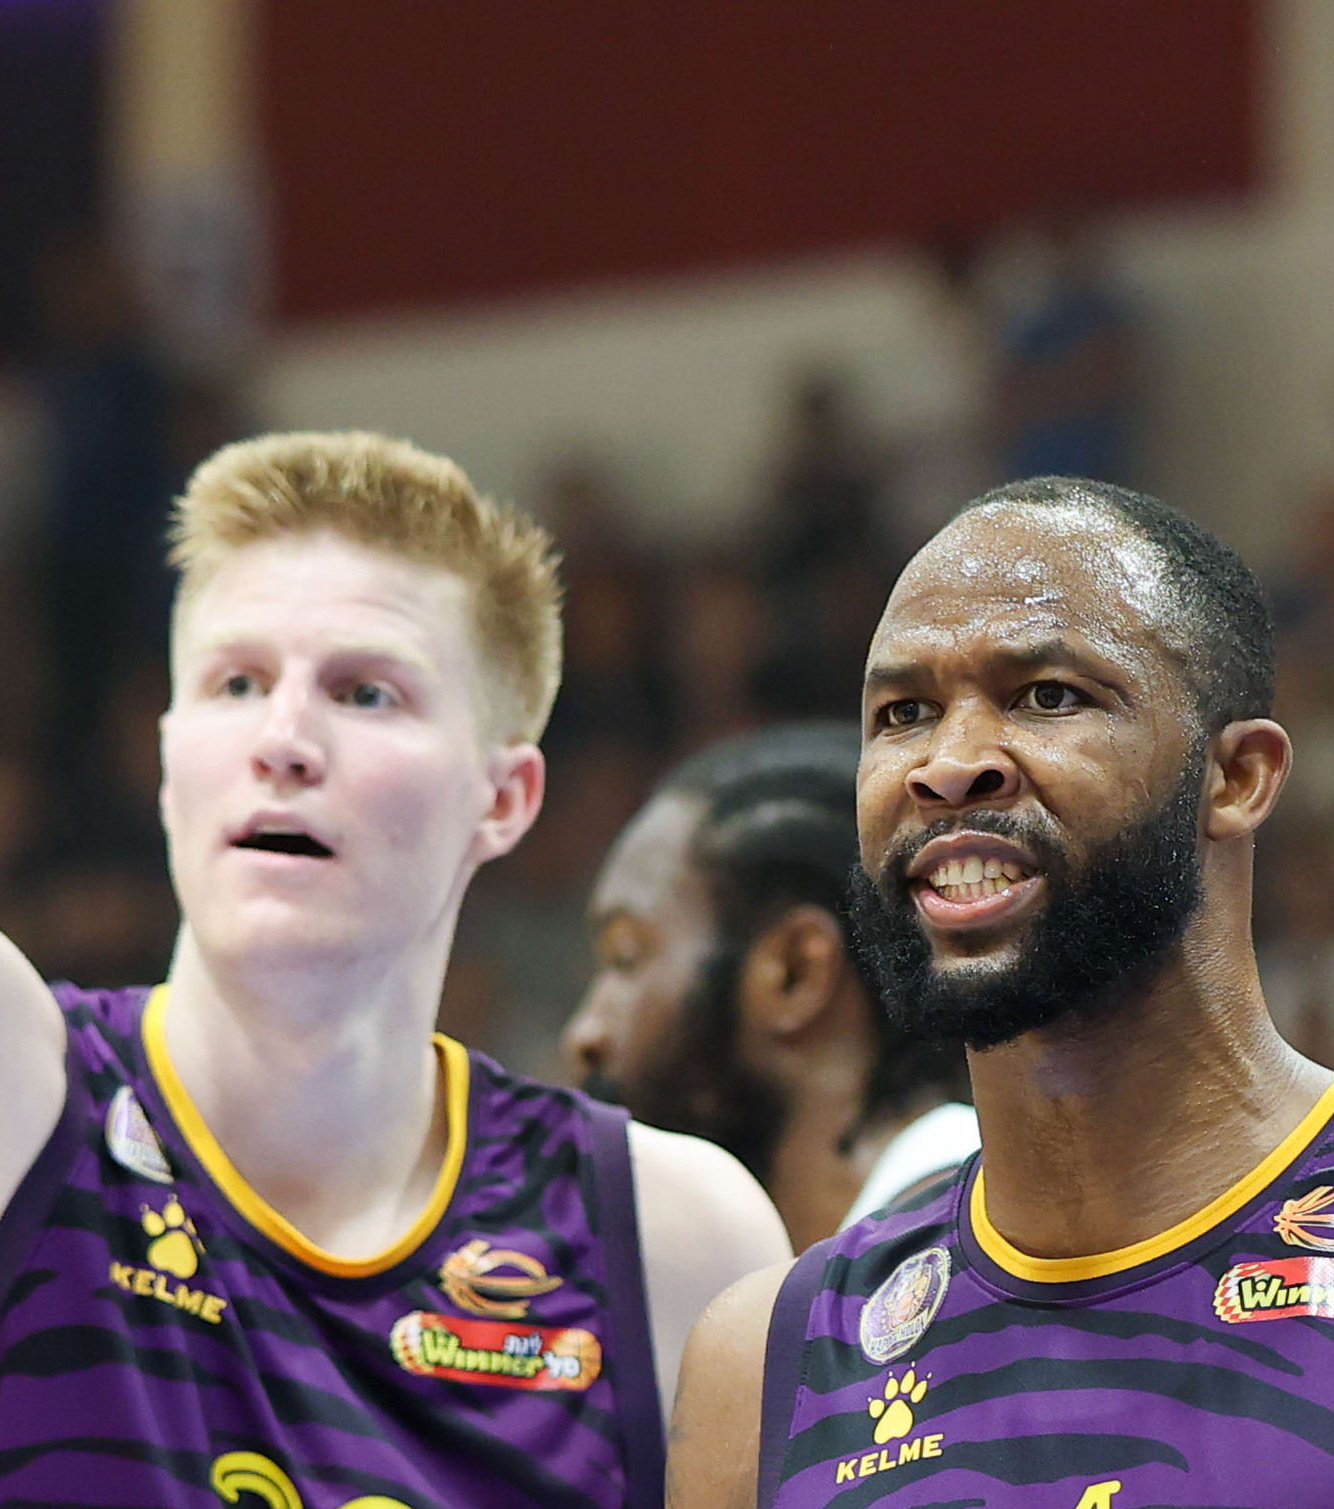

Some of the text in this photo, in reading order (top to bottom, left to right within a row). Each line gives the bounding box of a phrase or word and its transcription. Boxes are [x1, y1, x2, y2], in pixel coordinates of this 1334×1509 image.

[110, 1262, 228, 1324] KELME
[421, 1329, 545, 1378] Winner
[834, 1432, 944, 1484] KELME
